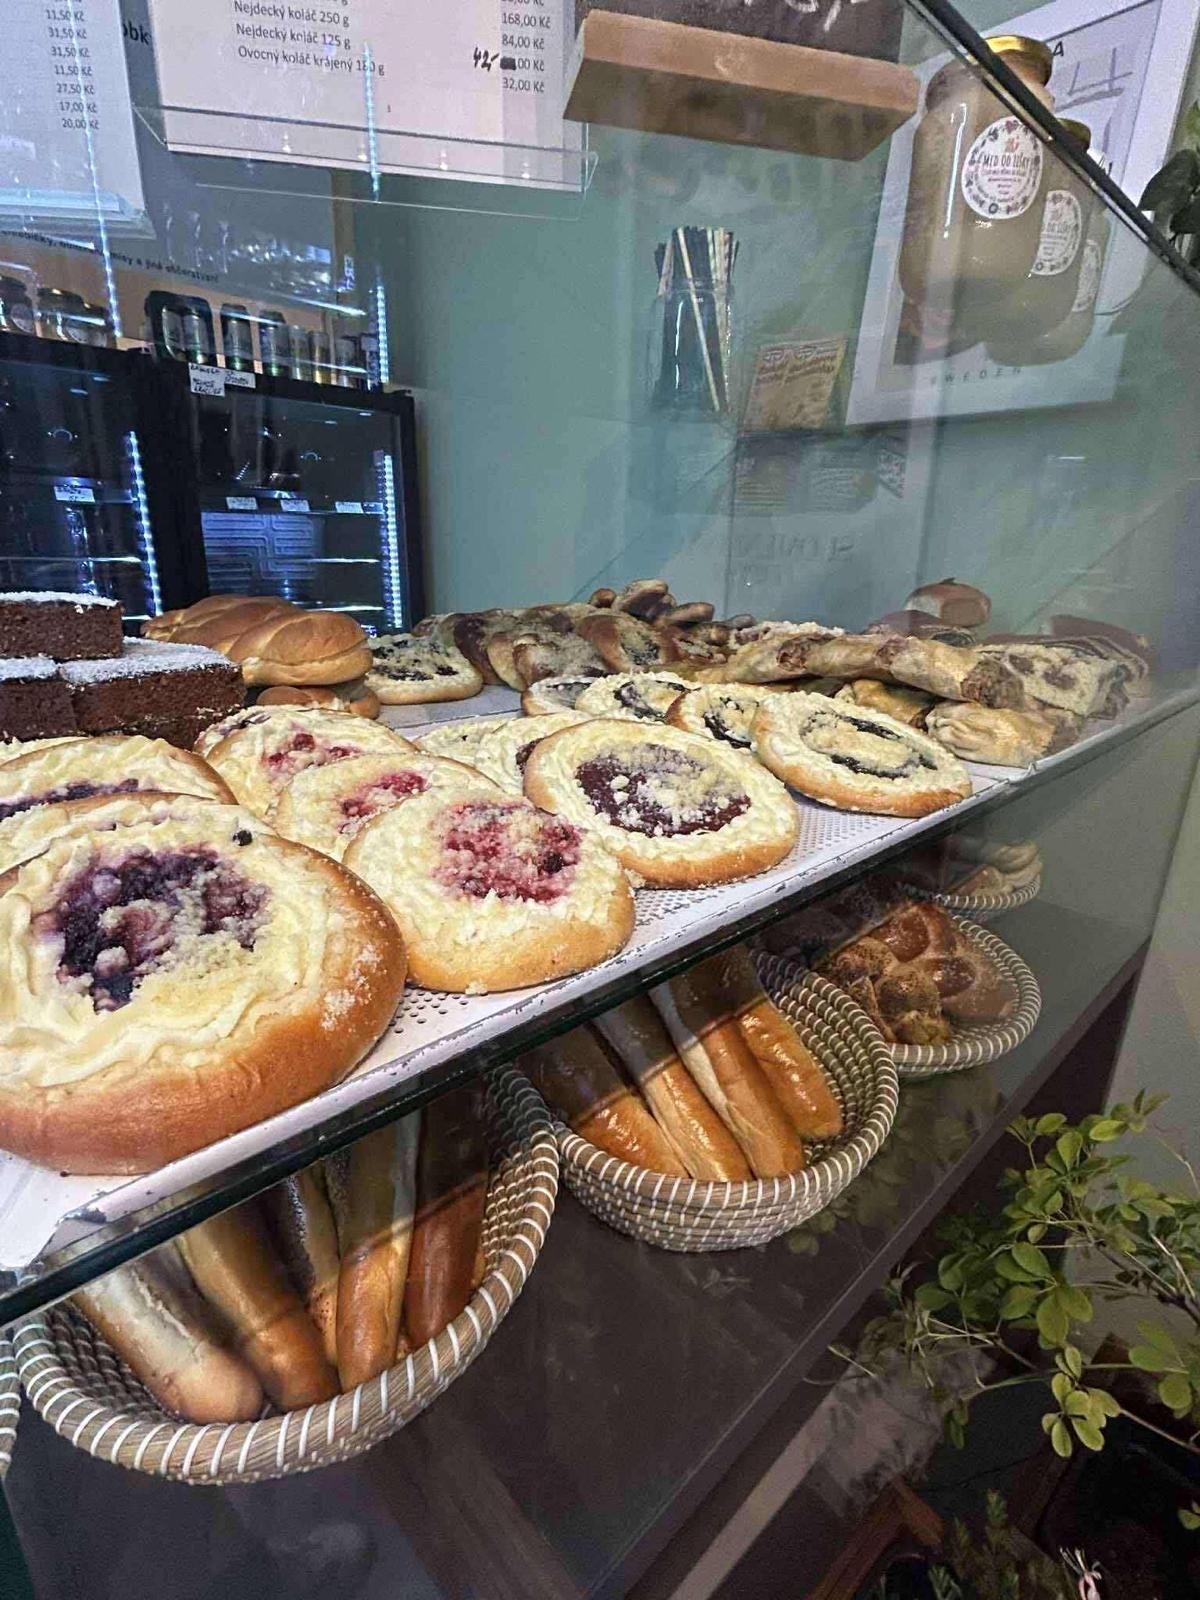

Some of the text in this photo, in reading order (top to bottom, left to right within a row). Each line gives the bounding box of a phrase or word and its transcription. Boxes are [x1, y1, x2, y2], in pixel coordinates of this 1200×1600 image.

[234, 1, 350, 28] Nejdecký koláč 250 g
[502, 13, 551, 29] 168,00 Kč
[236, 23, 351, 50] Nejdecký koláč 125 g
[502, 34, 545, 50] 84,00 Kč
[238, 46, 279, 64] Ovocný
[282, 50, 311, 65] koláč
[314, 54, 353, 72] krájený
[378, 64, 385, 76] g
[533, 60, 545, 72] Kč
[502, 77, 545, 93] 32,00 Kč
[60, 102, 97, 113] 17,00 Kč
[62, 118, 88, 130] 20,00
